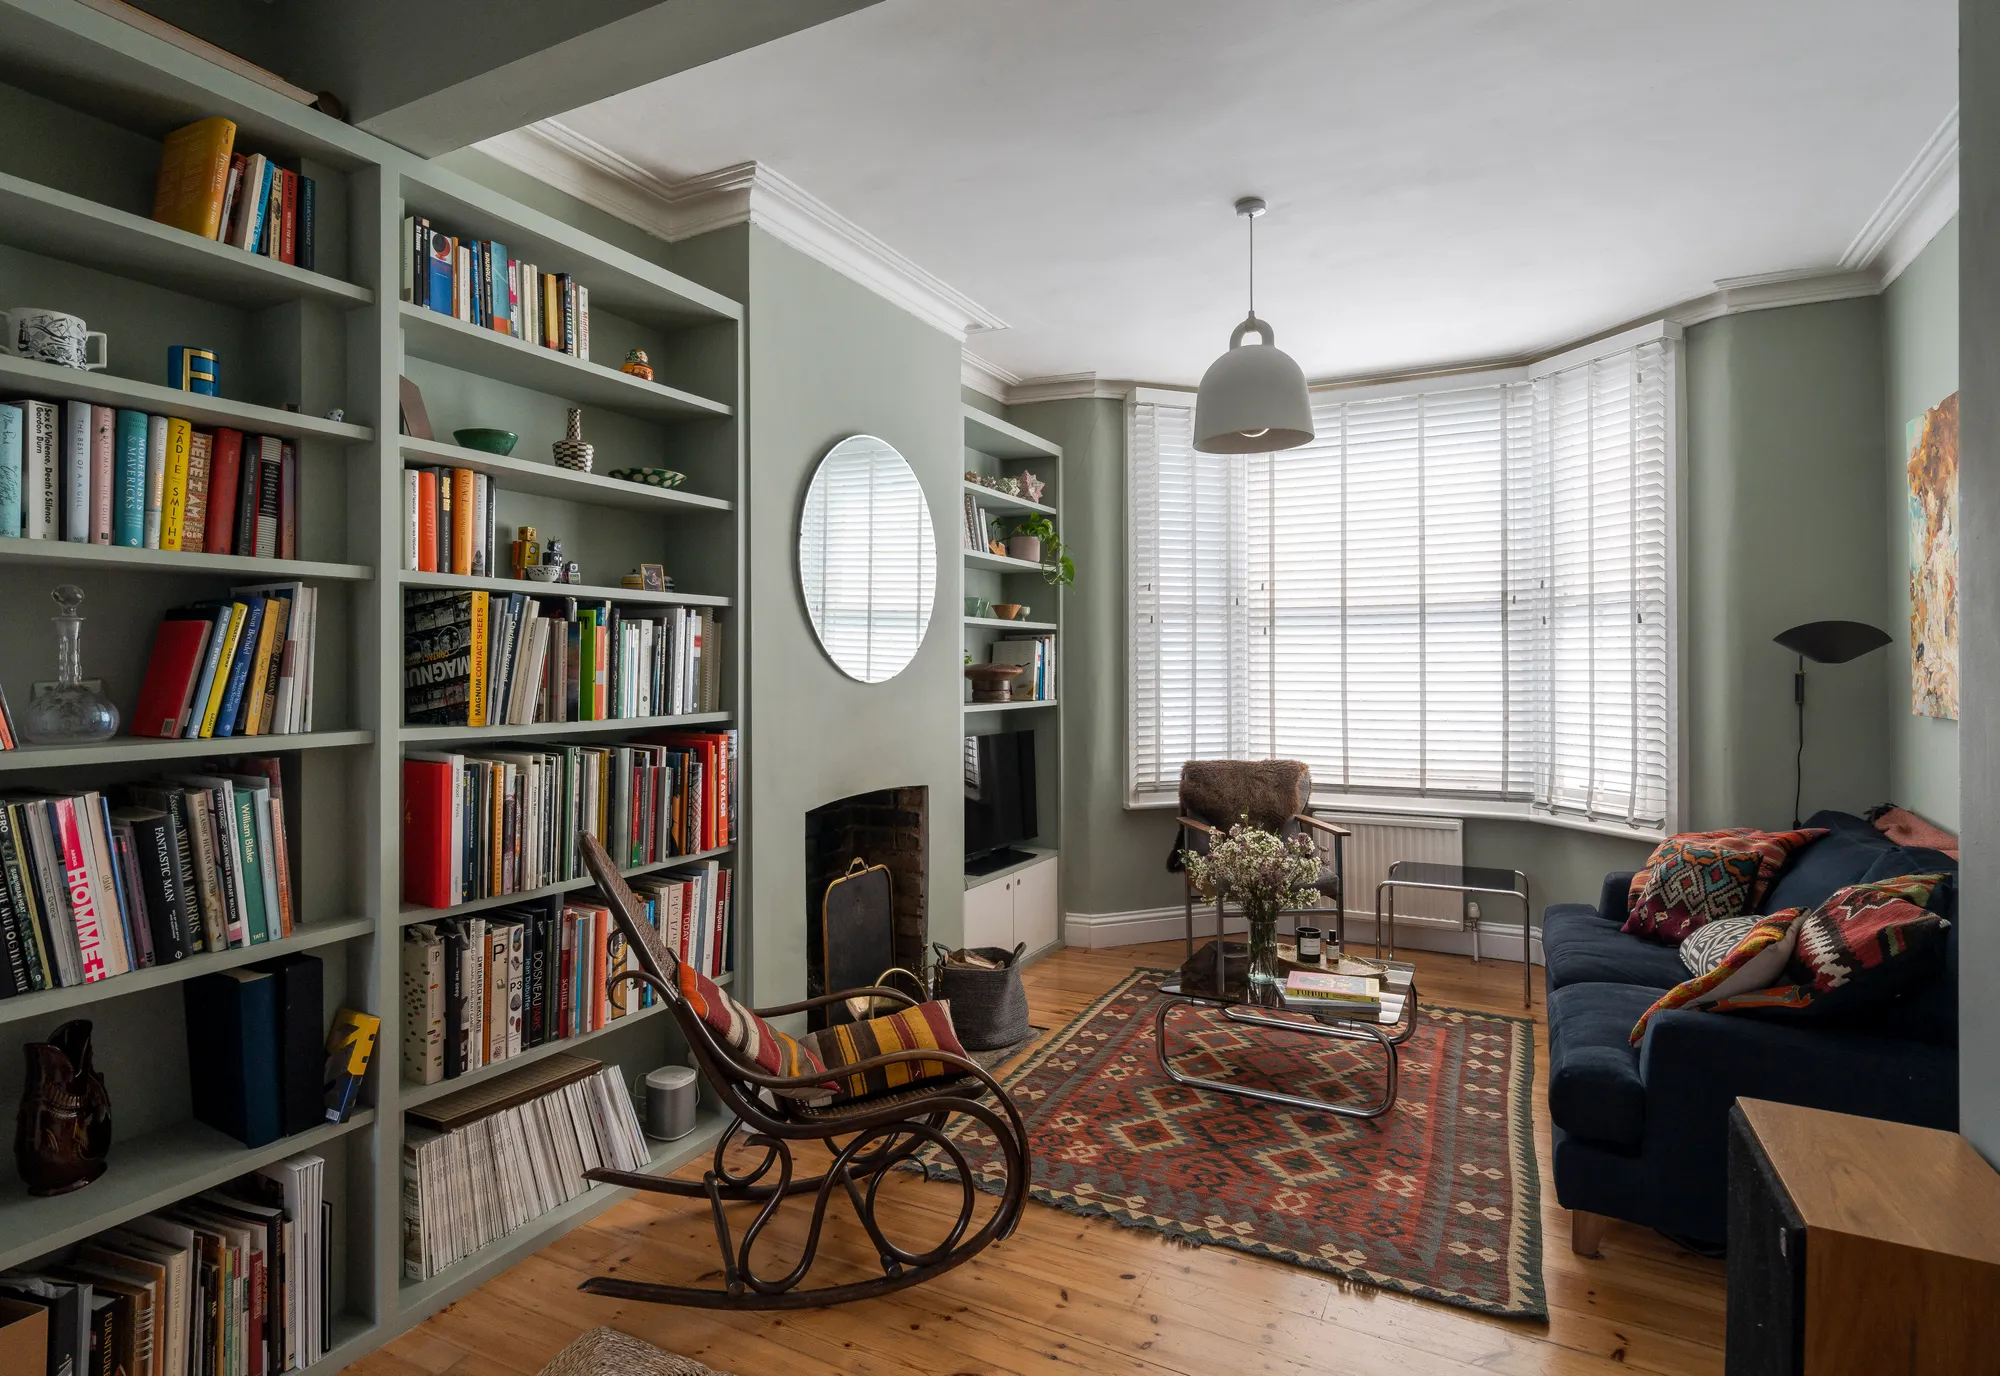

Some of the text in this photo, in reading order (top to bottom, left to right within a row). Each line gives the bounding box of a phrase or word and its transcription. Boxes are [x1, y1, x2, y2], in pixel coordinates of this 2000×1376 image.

[218, 152, 229, 189] Presence
[44, 407, 52, 421] Sex
[35, 436, 43, 453] Burn
[43, 431, 52, 464] Violence,
[174, 426, 184, 474] ZADIE
[77, 459, 82, 470] OF
[126, 435, 136, 509] & MAVERICKS
[136, 436, 145, 510] MODERNISTS
[186, 436, 206, 519] HERE I AM
[44, 497, 52, 523] Silence
[168, 487, 180, 536] SMITH
[243, 605, 261, 656] Alison Bechdel
[275, 630, 283, 644] THE
[475, 607, 483, 639] SHEETS
[507, 621, 515, 651] Charlotte
[210, 647, 220, 669] BEVERLY
[224, 647, 233, 668] SABRINA
[272, 644, 282, 662] POET
[422, 650, 449, 662] CONTACT
[225, 662, 244, 712] Superhuman Strength
[264, 662, 279, 708] ASSASSINATED
[404, 655, 470, 688] MAGNU
[236, 681, 245, 697] Secret
[474, 678, 482, 716] MAGNUM
[207, 712, 215, 733] GRANTA
[241, 803, 253, 863] William Blake
[155, 826, 175, 902] FANTASTIC MAN
[170, 795, 201, 933] Essential WILLIAM MORRIS
[198, 805, 216, 897] CLASSIC HUMAN ANATOMY
[11, 868, 26, 913] SUBURBAN HEAT
[682, 911, 690, 941] TODAY
[0, 907, 22, 966] ANDROGYNY
[14, 966, 29, 992] ISSUE
[510, 981, 522, 992] P3
[522, 976, 531, 1010] Dubuffet
[530, 951, 544, 1031] DOISNEAU PARIS
[560, 978, 568, 1009] SCHIELE
[1296, 990, 1328, 998] TUMULT
[102, 1311, 115, 1376] FURNITURE
